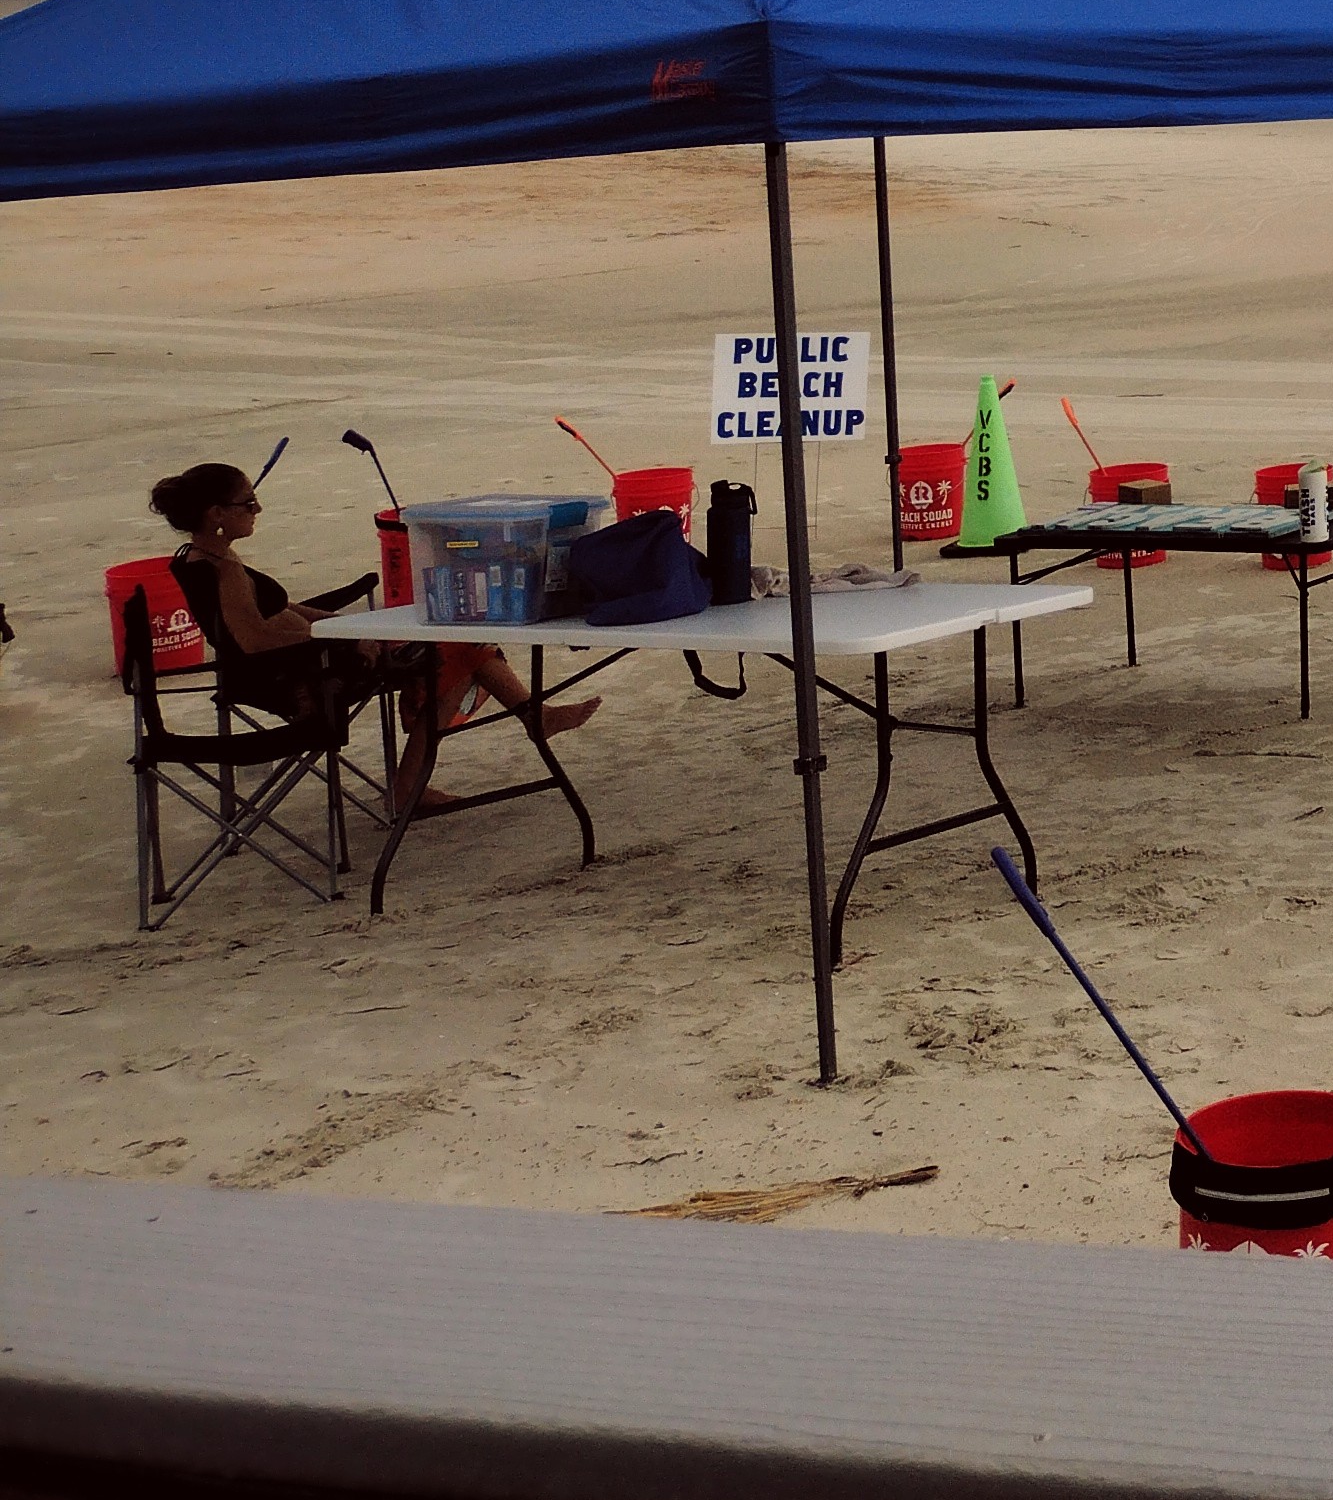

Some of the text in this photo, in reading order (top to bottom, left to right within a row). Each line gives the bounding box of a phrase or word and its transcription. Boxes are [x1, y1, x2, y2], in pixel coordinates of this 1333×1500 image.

[734, 337, 850, 364] PULIC
[738, 372, 843, 398] BECH
[717, 410, 864, 438] CLENUP
[977, 409, 991, 501] VCBS
[900, 509, 953, 522] EACH SQUAD
[1301, 489, 1311, 536] TRASH
[152, 634, 180, 647] BEACH
